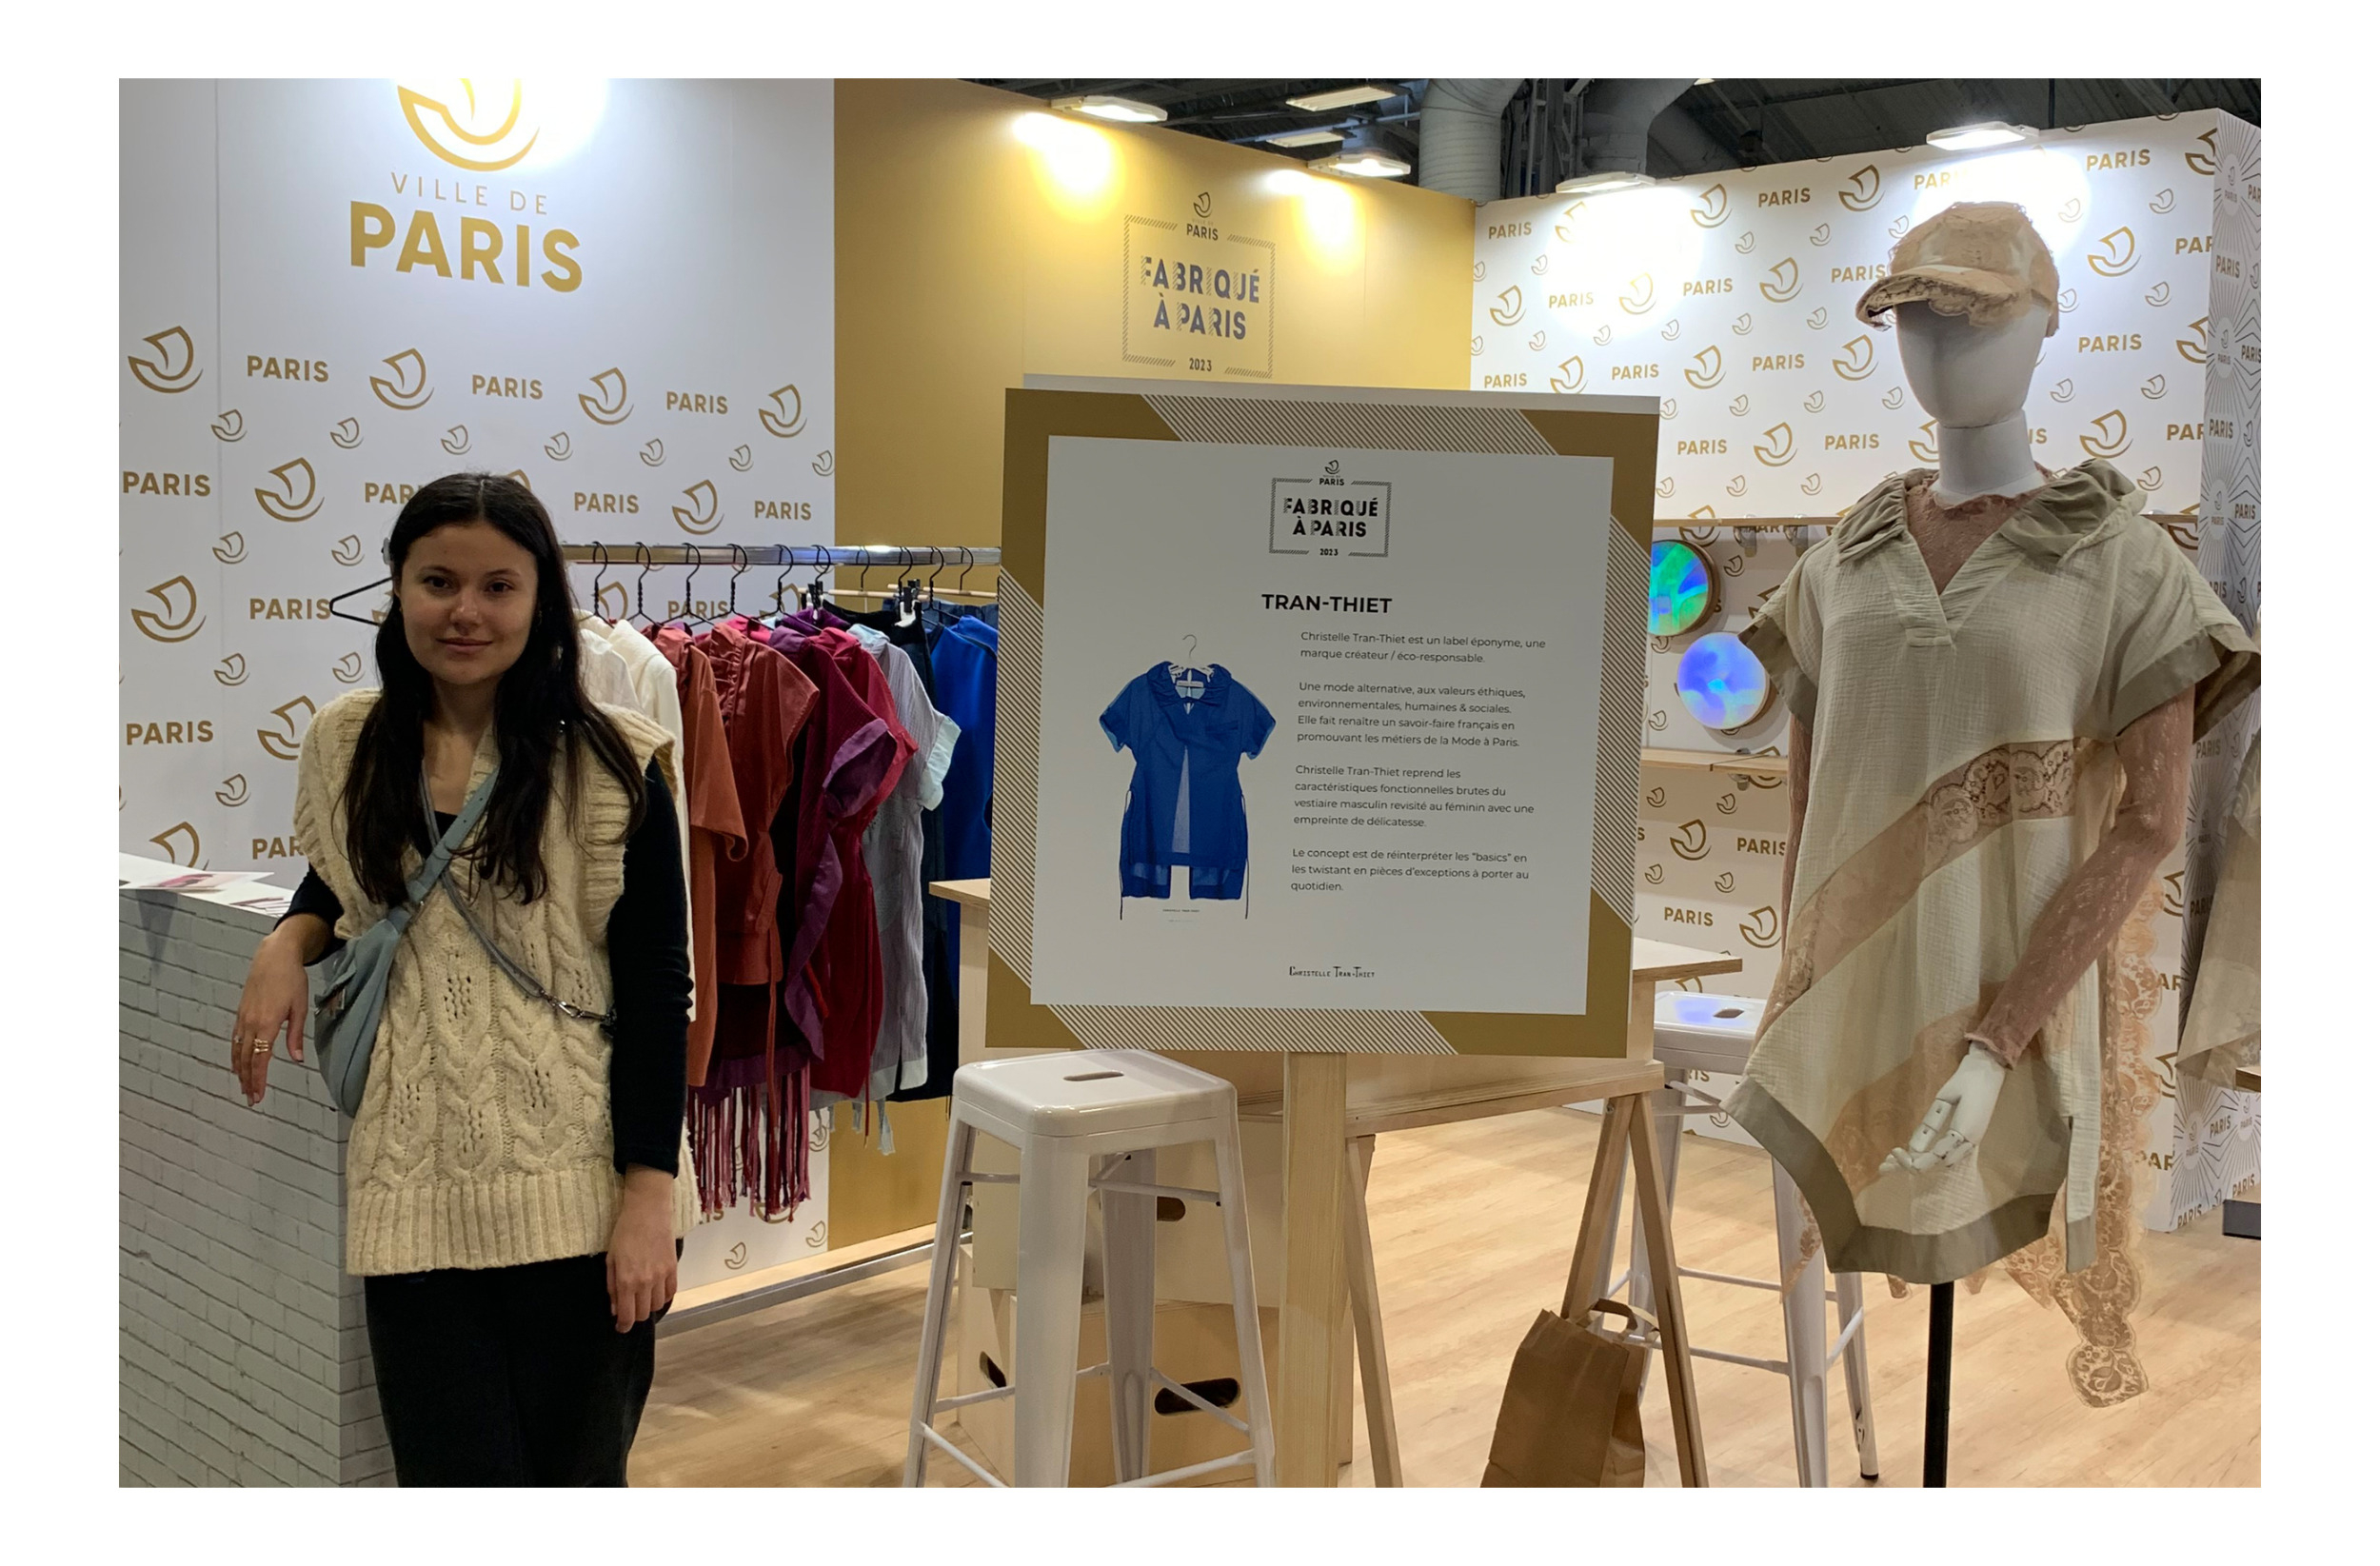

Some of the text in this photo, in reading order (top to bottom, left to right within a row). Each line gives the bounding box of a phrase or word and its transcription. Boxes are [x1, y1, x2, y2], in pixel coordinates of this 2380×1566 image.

[2086, 149, 2151, 171] PARIS
[391, 171, 548, 215] VILLE DE
[1758, 188, 1811, 208] PARIS
[1186, 223, 1219, 241] PARIS
[1488, 222, 1532, 239] PARIS
[350, 201, 583, 293] PARIS
[1832, 264, 1886, 283] PARIS
[2216, 254, 2240, 278] PARIS
[1141, 255, 1259, 303] FABRIQUÉ
[1683, 278, 1733, 296] PARIS
[1549, 291, 1594, 308] PARIS
[1153, 292, 1246, 340] À PARIS
[2078, 334, 2142, 353] PARIS
[247, 355, 328, 383] PARIS
[1189, 357, 1212, 372] 2023
[1612, 364, 1659, 380] PARIS
[1753, 354, 1805, 371] PARIS
[472, 375, 543, 400] PARIS
[1484, 373, 1527, 388] PARIS
[666, 391, 728, 415] PARIS
[2209, 419, 2233, 439] PARIS
[1677, 439, 1727, 455] PARIS
[1825, 434, 1879, 450] PARIS
[122, 472, 210, 497] PARIS
[1319, 478, 1345, 486] PARIS
[365, 483, 421, 504] PAR
[574, 492, 640, 515] PARIS
[755, 501, 811, 522] PARIS
[1283, 497, 1378, 517] FABRIQUÉ
[2234, 503, 2256, 520] PARIS
[1292, 515, 1367, 538] À PARIS
[1319, 548, 1339, 557] 2023
[249, 599, 330, 620] PARIS
[668, 601, 728, 619] PARIS
[1260, 593, 1394, 614] TRAN-THIET
[1300, 631, 1546, 649] Christelle Tran-Thiet est un label éponyme, une
[1299, 649, 1486, 664] marque créateur / éco-responsable.
[1299, 681, 1526, 700] Une mode alternative, aux valeurs éthiques,
[1298, 698, 1512, 714] environnementales, humaines & sociales.
[1298, 714, 1516, 732] Elle fait renaître un savoir-faire français en
[127, 721, 214, 745] PARIS
[1297, 733, 1520, 747] promouvant les métiers de la Mode à Paris.
[2196, 739, 2221, 759] PARIS
[1295, 764, 1461, 780] Christelle Tran-Thiet reprend les
[1294, 782, 1507, 797] caractéristiques fonctionnelles brutes du
[1294, 798, 1535, 814] vestiaire masculin revisité au féminin avec une
[1293, 815, 1427, 827] empreinte de délicatesse.
[252, 838, 304, 860] PAR
[1292, 848, 1306, 858] Le
[1306, 849, 1351, 860] concept
[1352, 850, 1369, 859] est
[1370, 849, 1385, 860] de
[1386, 849, 1454, 862] réinterpréter
[1455, 851, 1470, 862] les
[1513, 855, 1528, 863] en
[1736, 837, 1787, 857] PARIS
[1291, 863, 1307, 874] les
[1308, 864, 1352, 876] twistant
[1353, 867, 1367, 876] en
[1369, 865, 1403, 878] pièces
[1472, 868, 1479, 879] à
[1480, 870, 1514, 881] porter
[1515, 871, 1530, 880] au
[1290, 881, 1344, 892] quotidien.
[1664, 906, 1714, 926] PARIS
[2210, 1115, 2231, 1139] PARIS
[2232, 1173, 2255, 1197] PARIS
